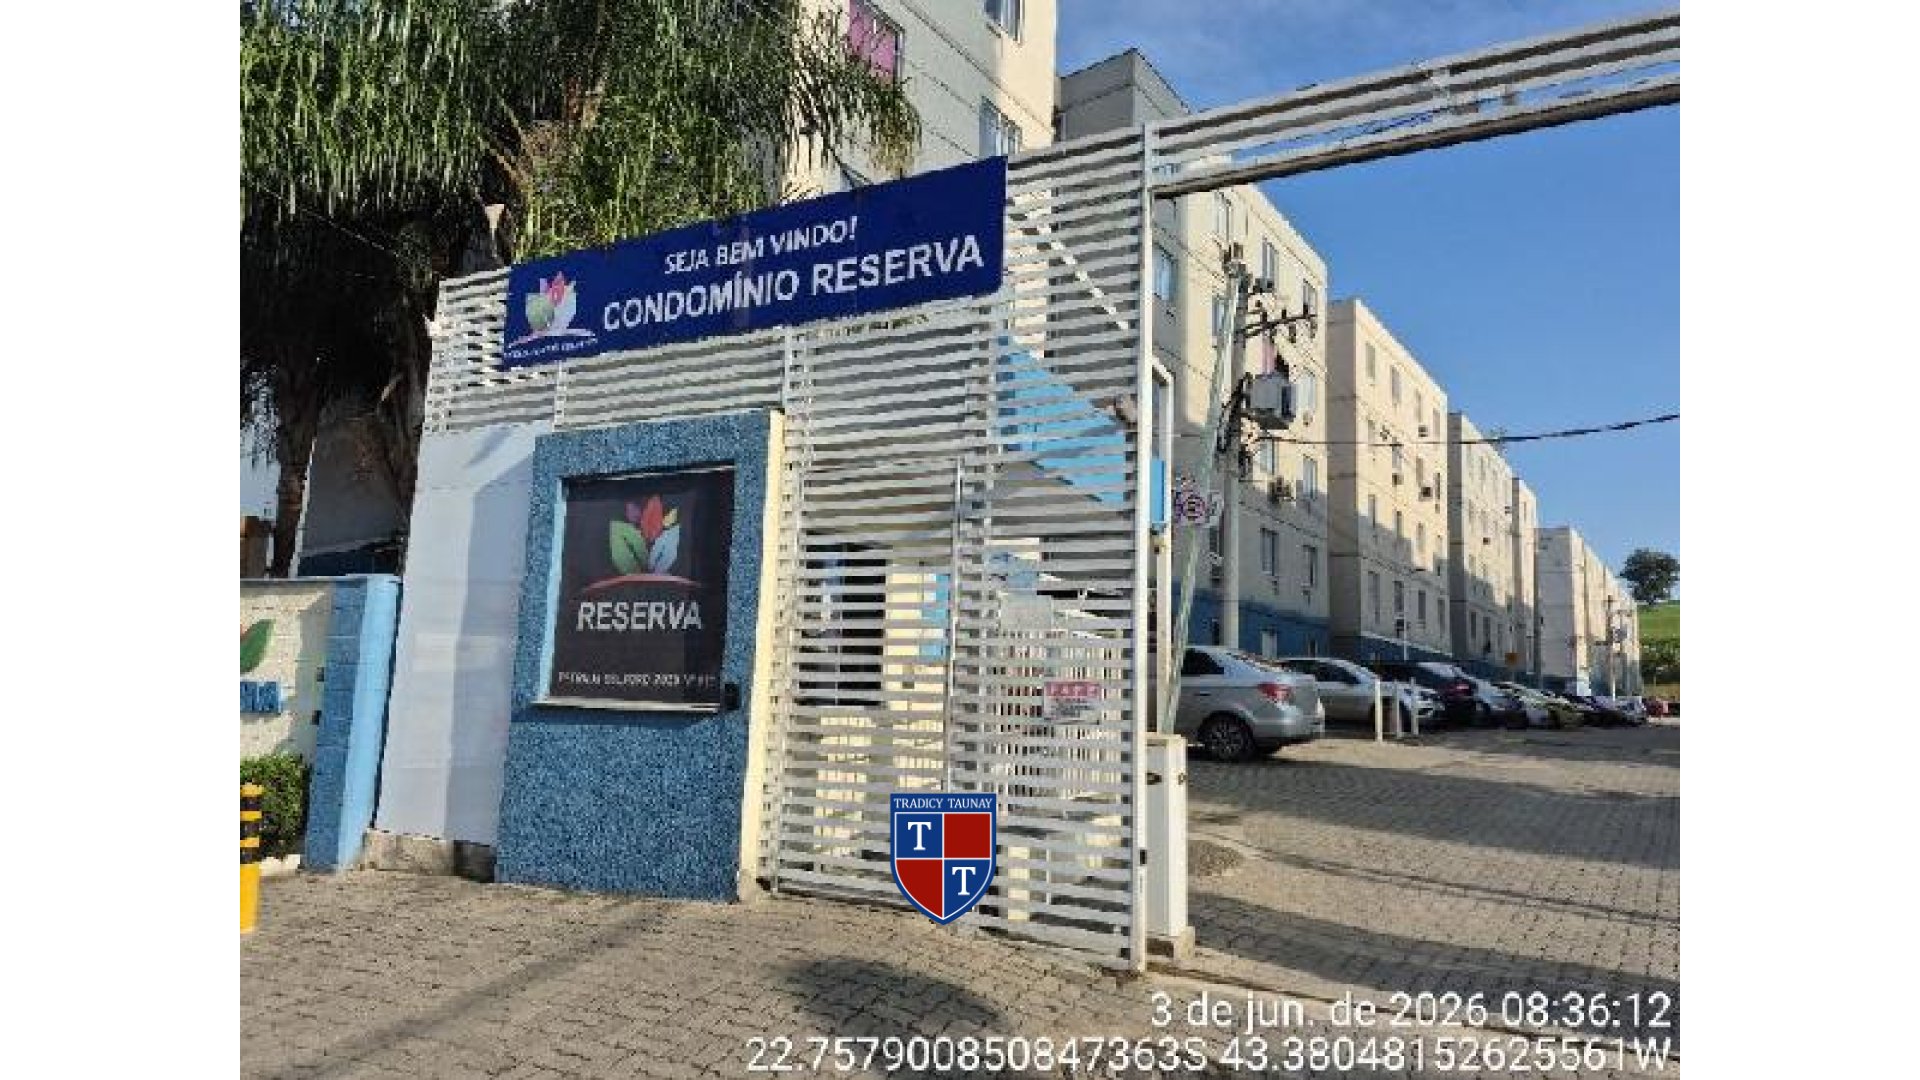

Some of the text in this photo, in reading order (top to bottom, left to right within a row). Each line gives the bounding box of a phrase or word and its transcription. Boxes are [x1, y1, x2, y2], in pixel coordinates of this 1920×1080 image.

[664, 215, 858, 275] SEJA BEM VINDO!
[603, 233, 985, 331] CONDOMÍNIO RESERVA
[576, 601, 702, 631] RESERVA
